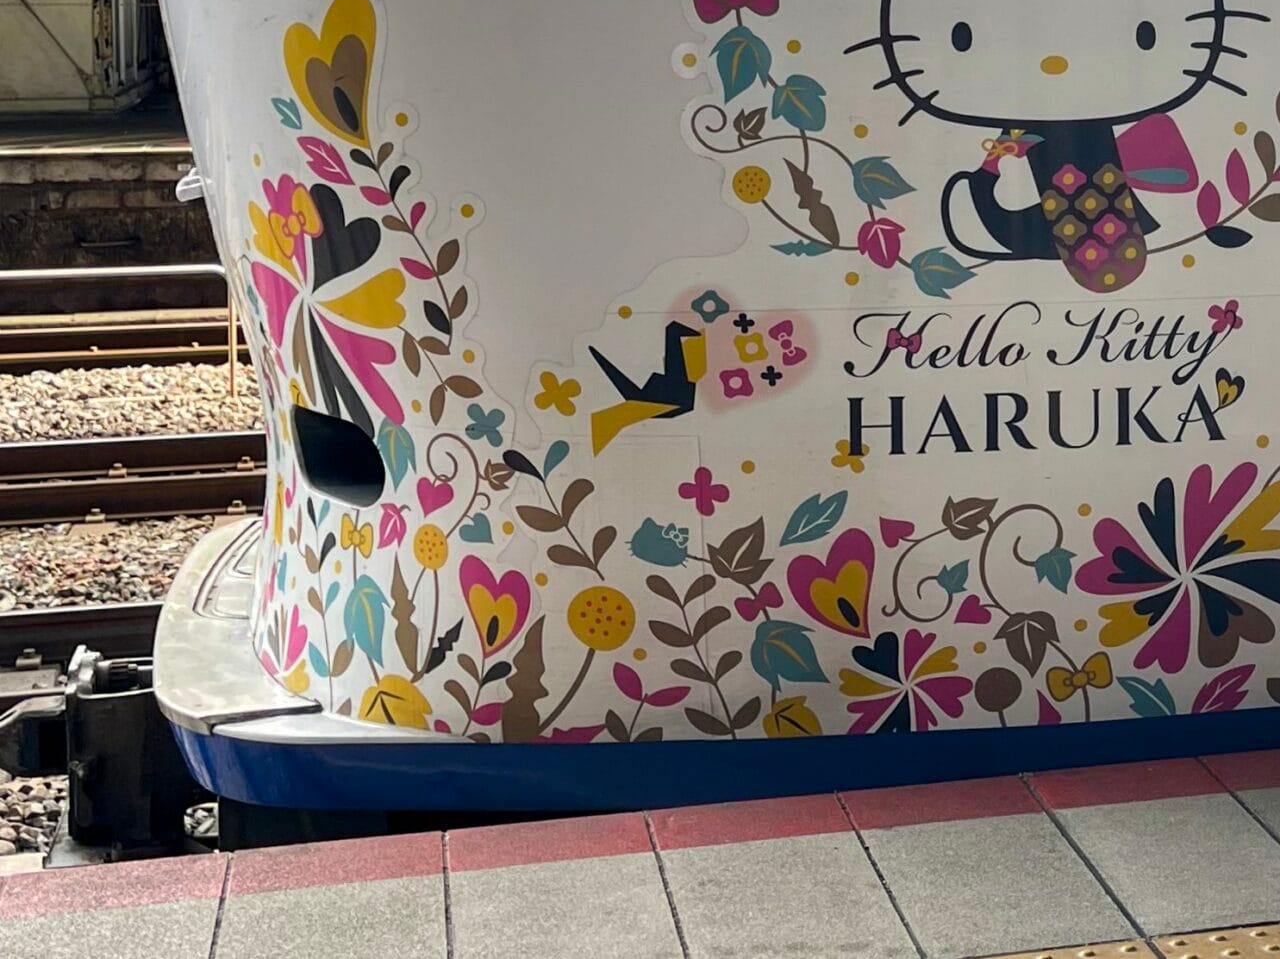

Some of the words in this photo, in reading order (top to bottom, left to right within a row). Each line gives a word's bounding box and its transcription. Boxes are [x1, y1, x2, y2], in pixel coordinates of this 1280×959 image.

[843, 300, 1042, 378] Hello
[1046, 307, 1238, 385] Kitty
[846, 383, 1227, 457] HARUKA
